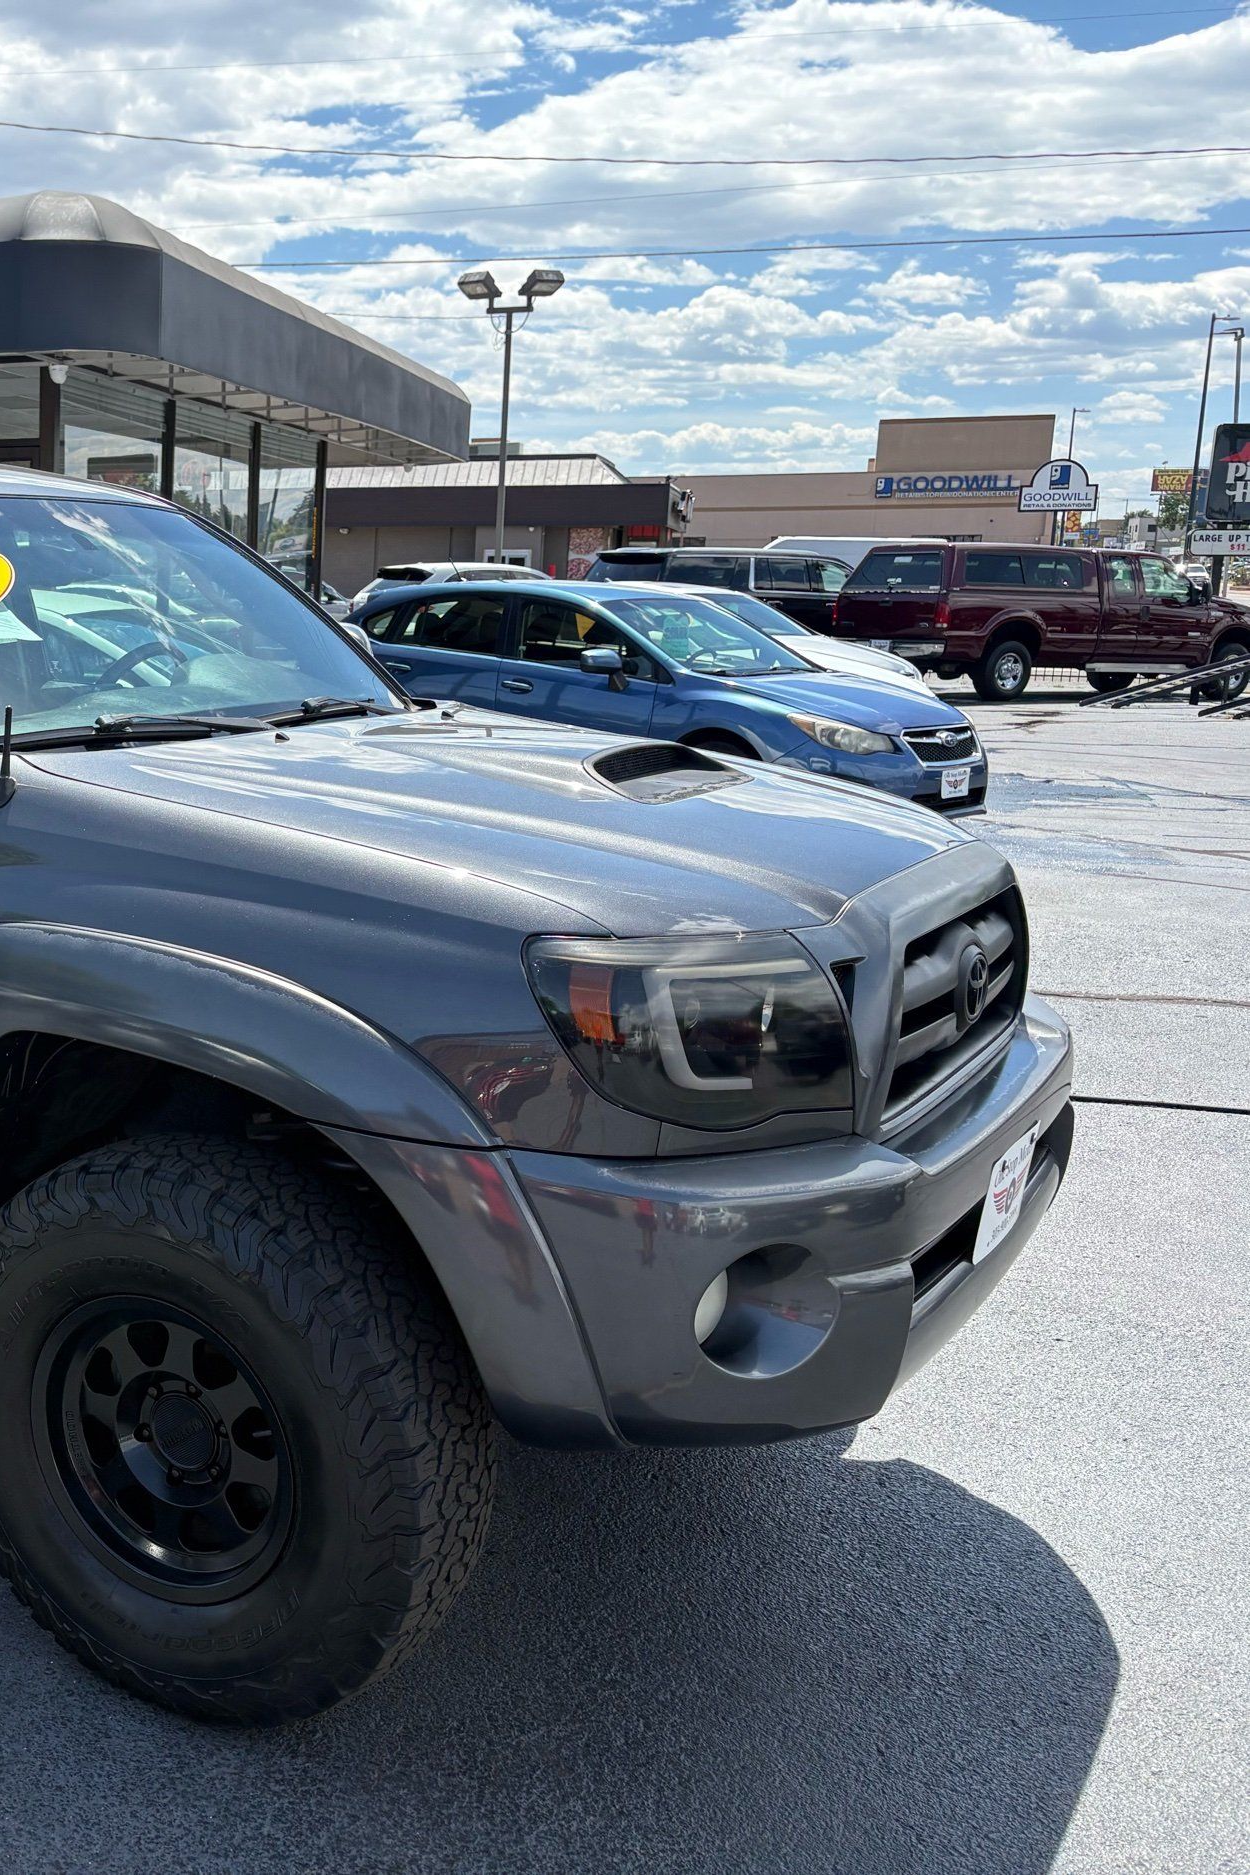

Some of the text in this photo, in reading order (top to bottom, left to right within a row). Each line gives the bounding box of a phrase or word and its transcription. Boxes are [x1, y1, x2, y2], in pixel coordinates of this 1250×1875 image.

[896, 474, 1019, 492] GOODWILL
[1157, 474, 1189, 485] AZAR
[953, 490, 989, 498] DONATION
[991, 489, 1019, 497] CENTER
[1023, 492, 1092, 502] GOODWILL
[1193, 534, 1223, 543] LARGE
[1228, 534, 1242, 543] UP
